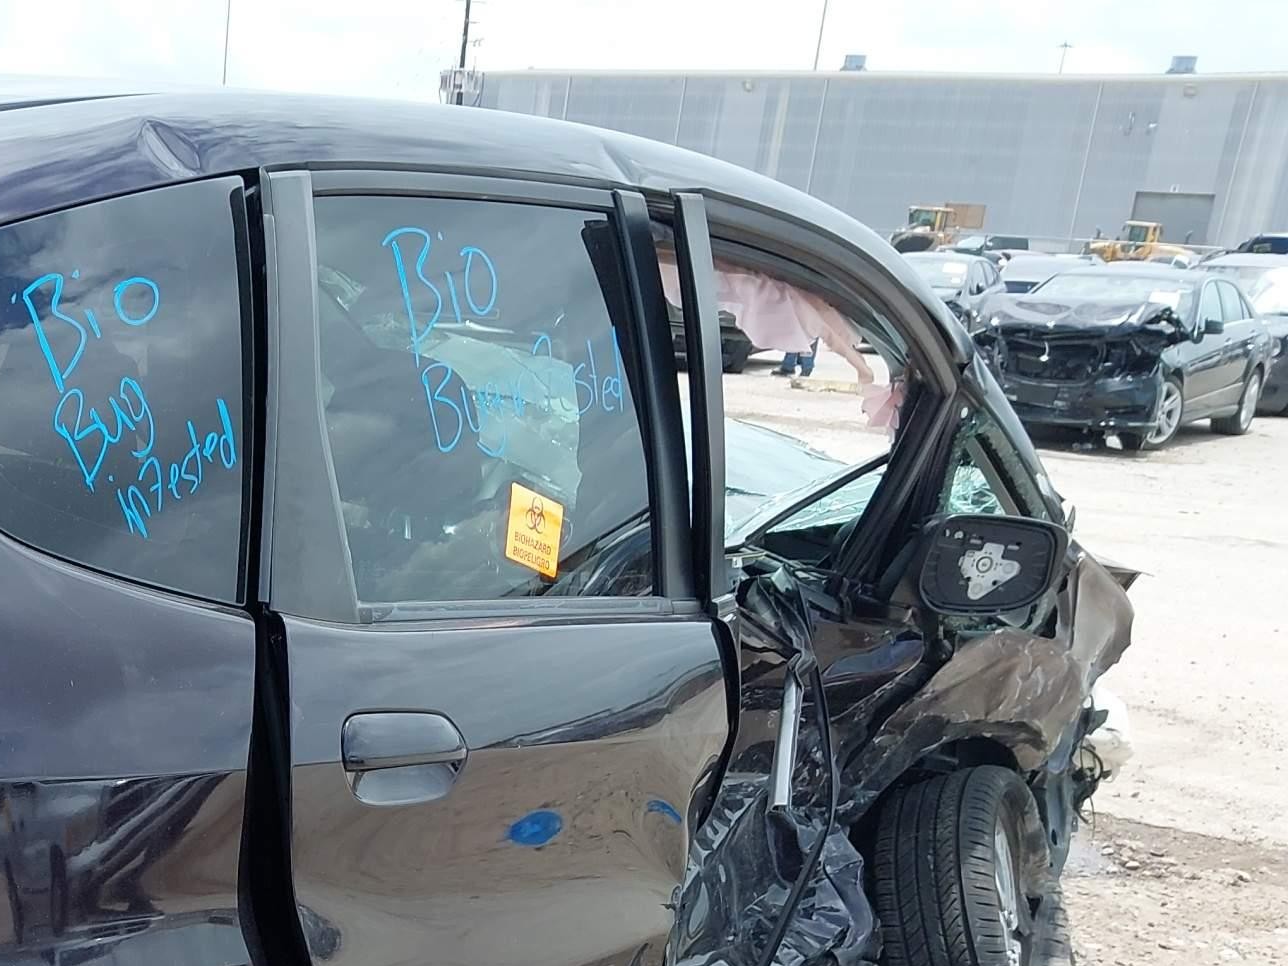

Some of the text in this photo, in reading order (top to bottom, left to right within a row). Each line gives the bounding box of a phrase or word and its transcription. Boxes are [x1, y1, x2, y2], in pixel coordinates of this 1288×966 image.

[54, 377, 154, 494] Bug
[514, 531, 552, 556] BIOHAZARD
[512, 546, 550, 570] BIOPELIGRO
